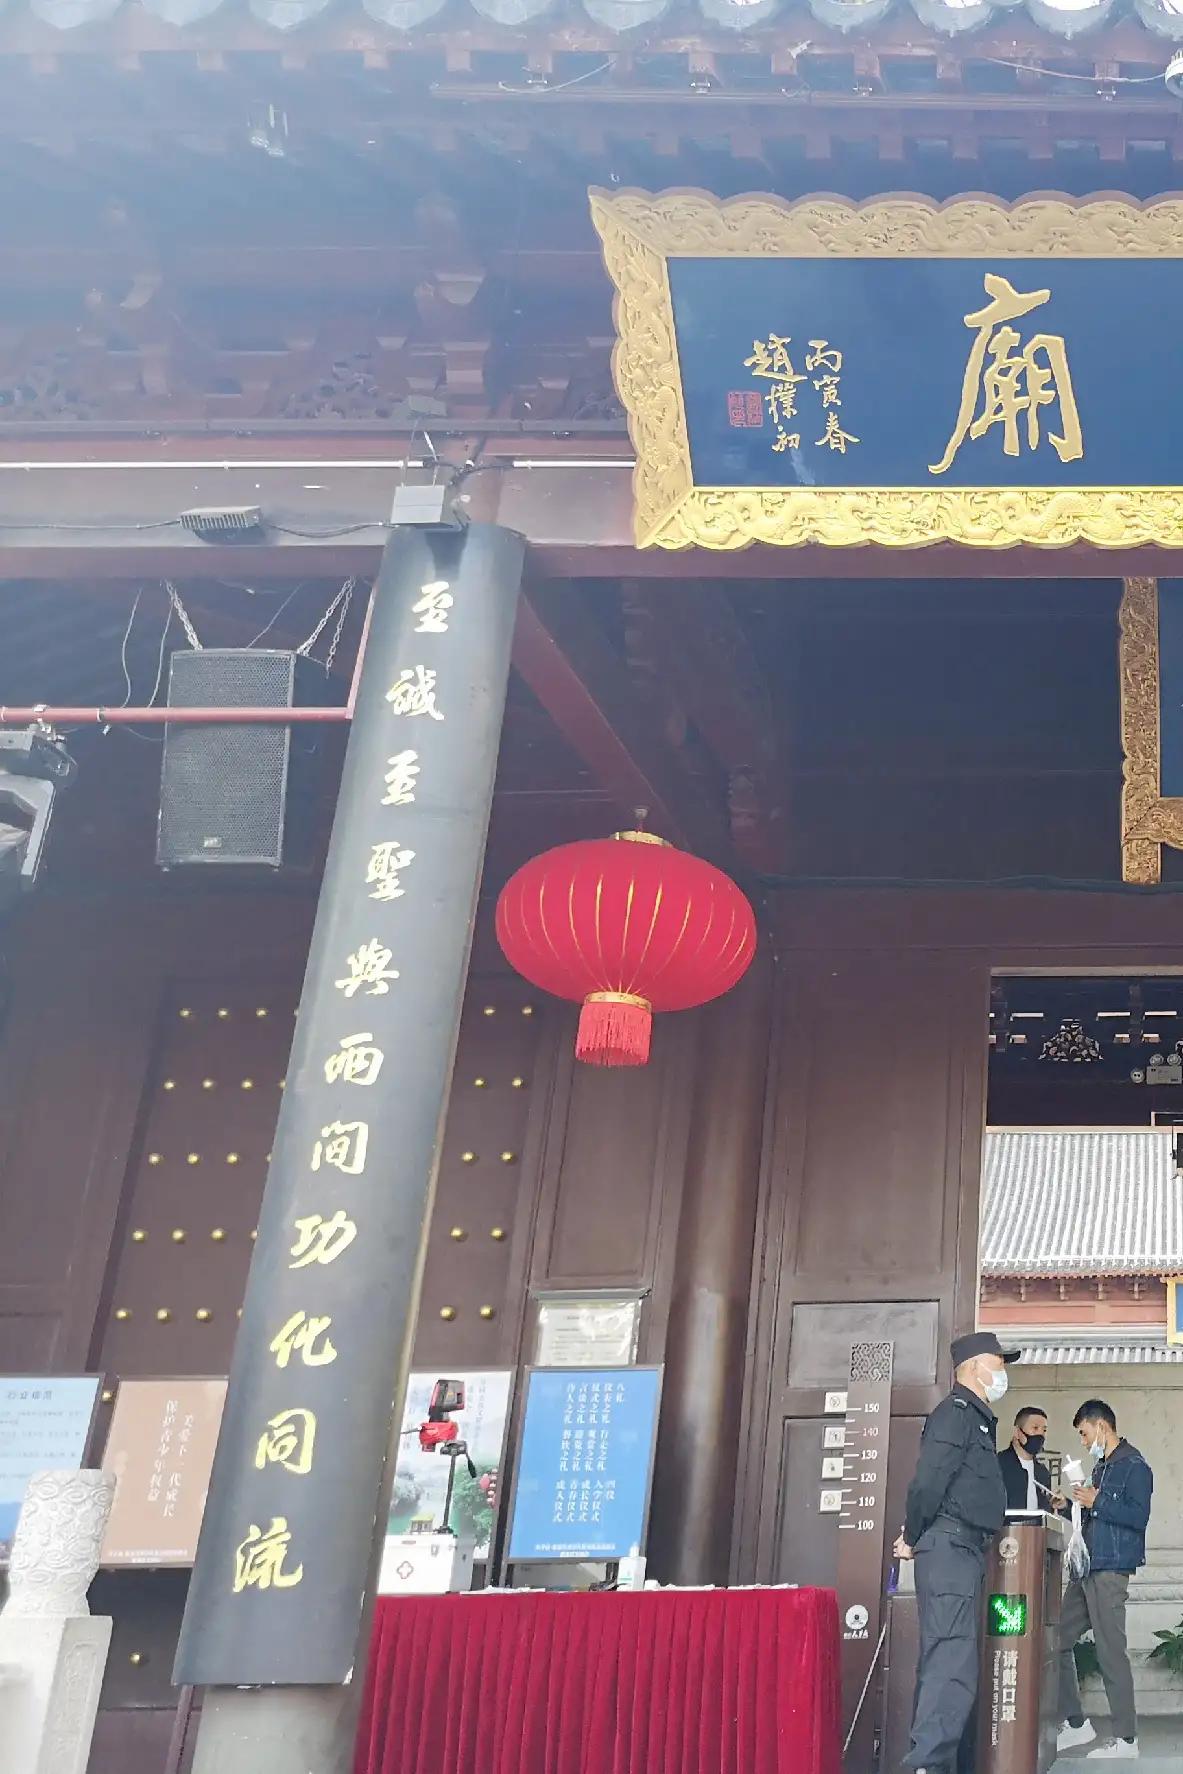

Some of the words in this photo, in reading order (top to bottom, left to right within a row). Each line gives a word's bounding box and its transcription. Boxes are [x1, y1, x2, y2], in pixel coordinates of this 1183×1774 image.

[864, 1403, 880, 1413] 150
[861, 1449, 878, 1460] 130
[860, 1473, 877, 1483] 120
[858, 1496, 875, 1507] 110
[857, 1519, 874, 1531] 100
